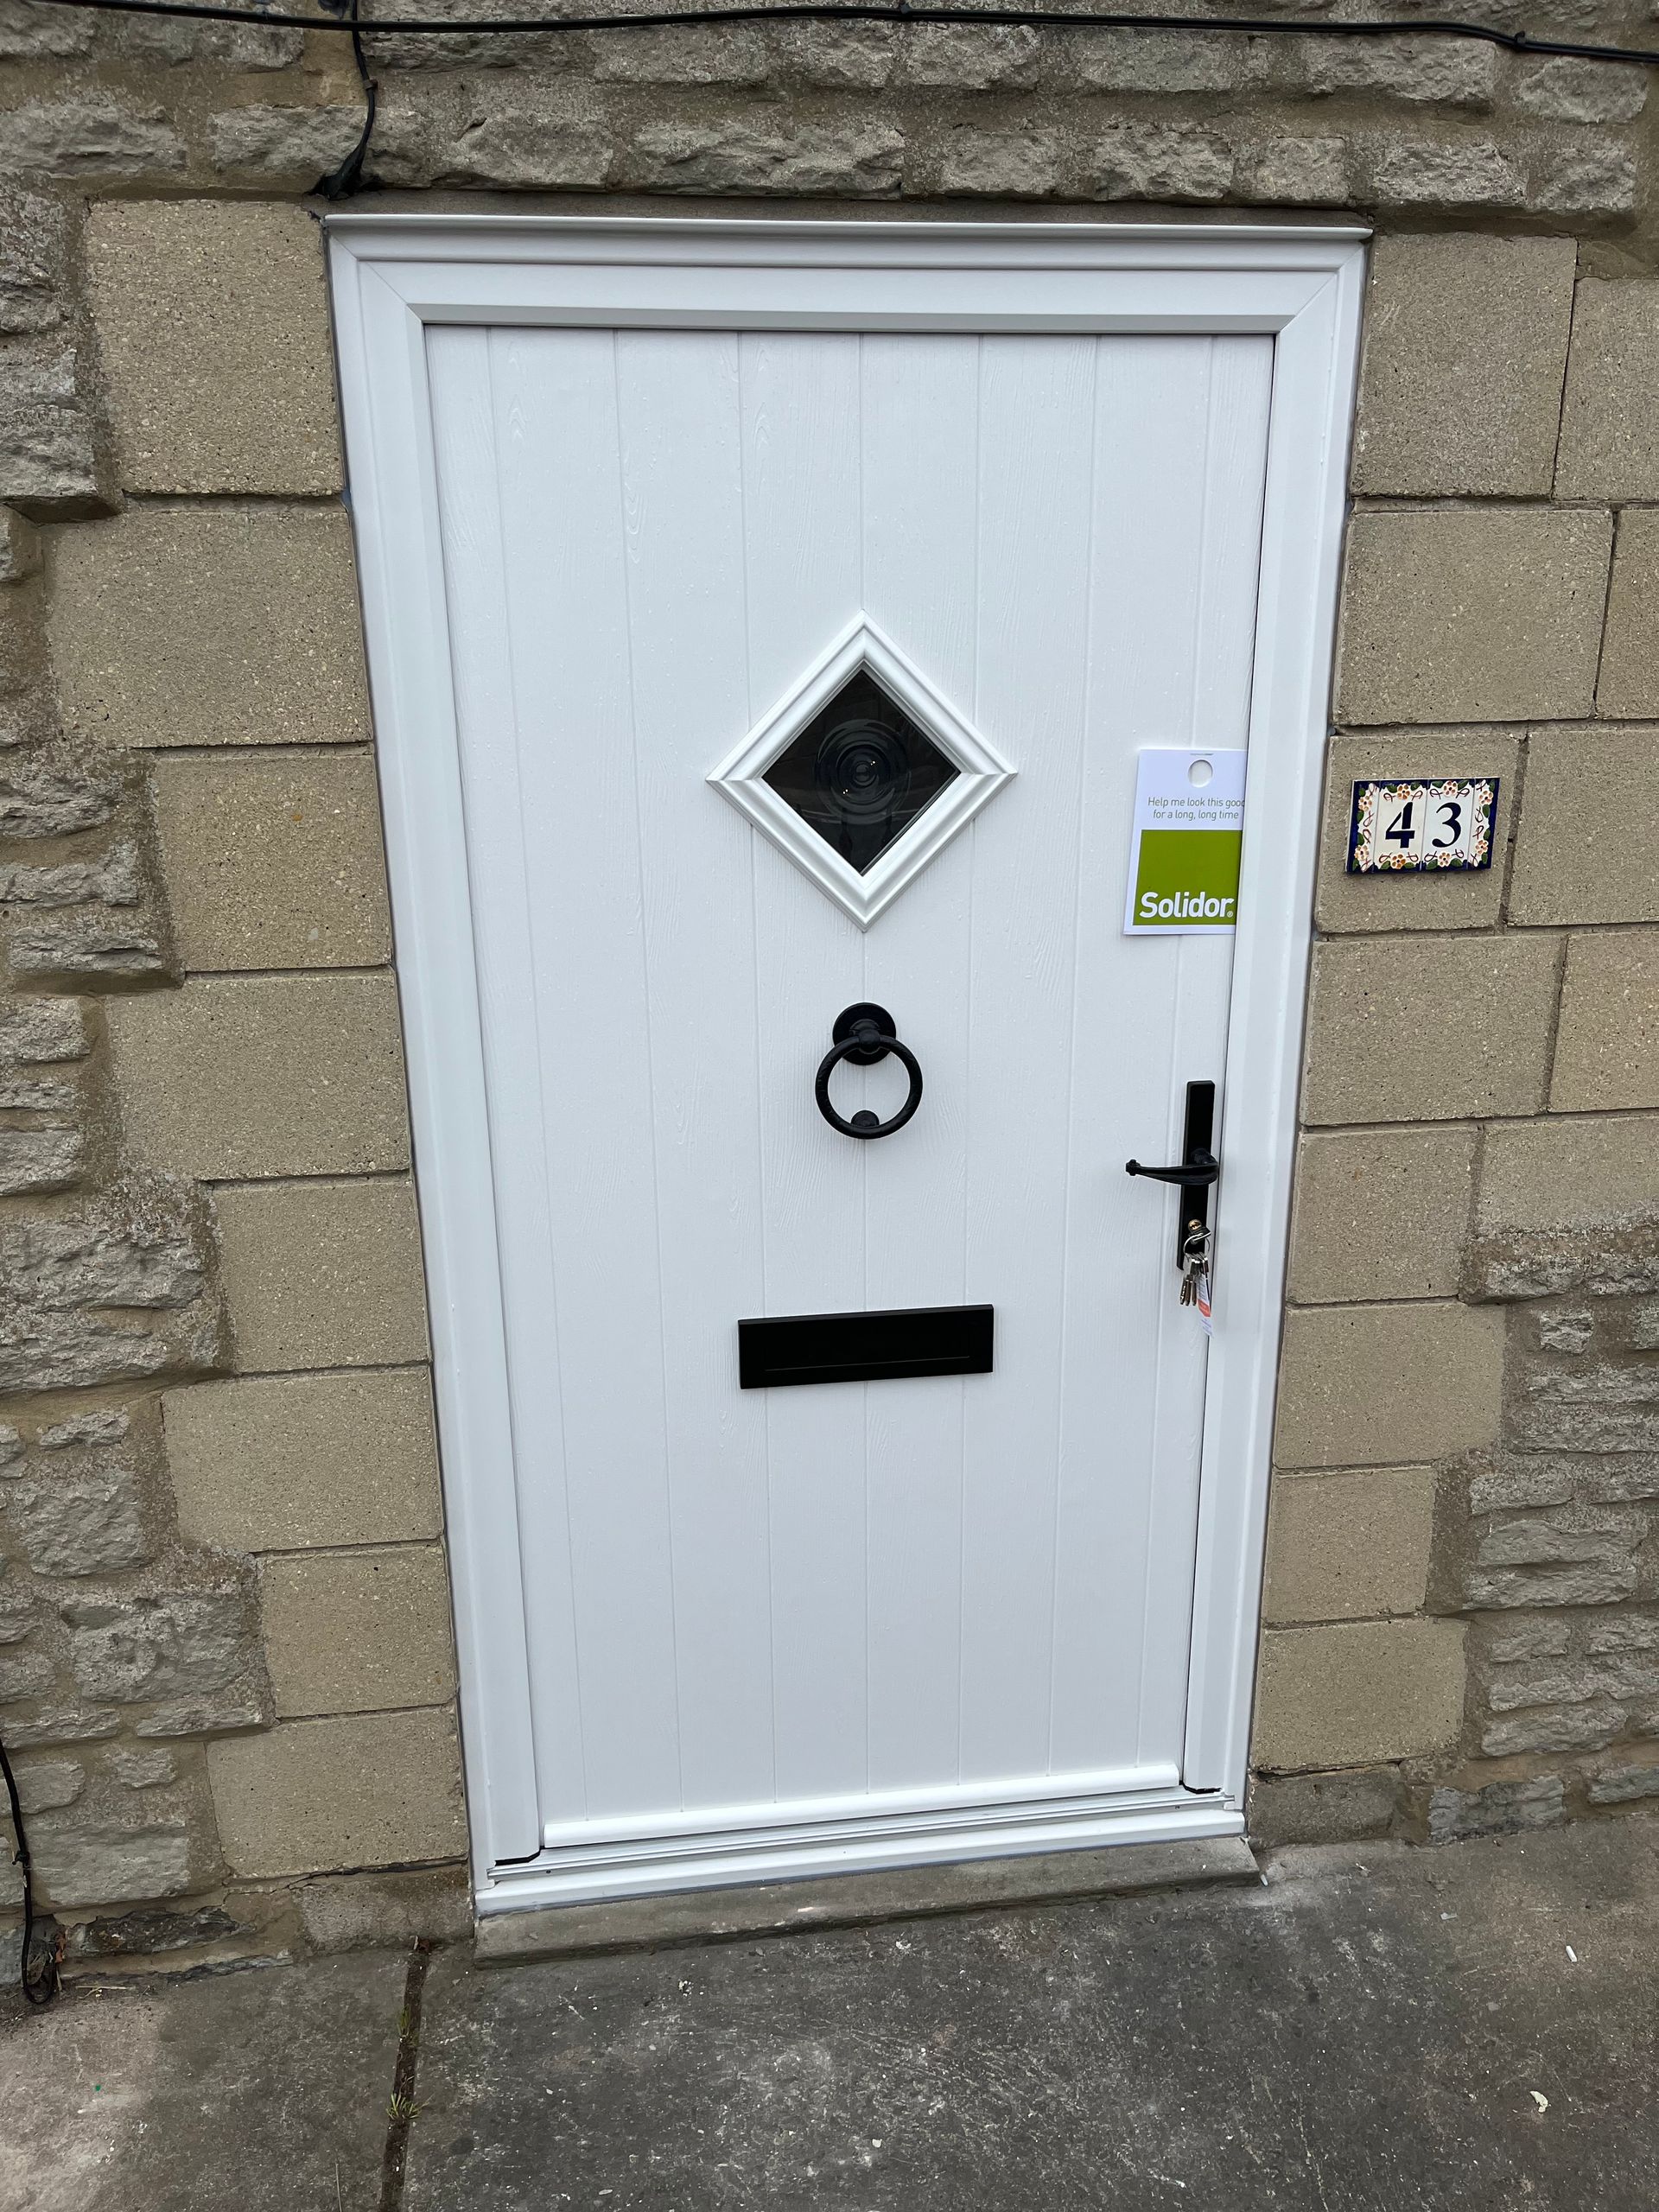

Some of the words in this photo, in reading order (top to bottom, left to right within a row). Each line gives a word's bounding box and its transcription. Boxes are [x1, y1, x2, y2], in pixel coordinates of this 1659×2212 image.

[1147, 797, 1169, 808] Help
[1187, 797, 1205, 806] look
[1207, 798, 1224, 807] this
[1153, 809, 1166, 818] for
[1175, 810, 1196, 821] long,
[1198, 810, 1217, 821] long
[1219, 810, 1239, 819] time
[1385, 802, 1462, 849] 43
